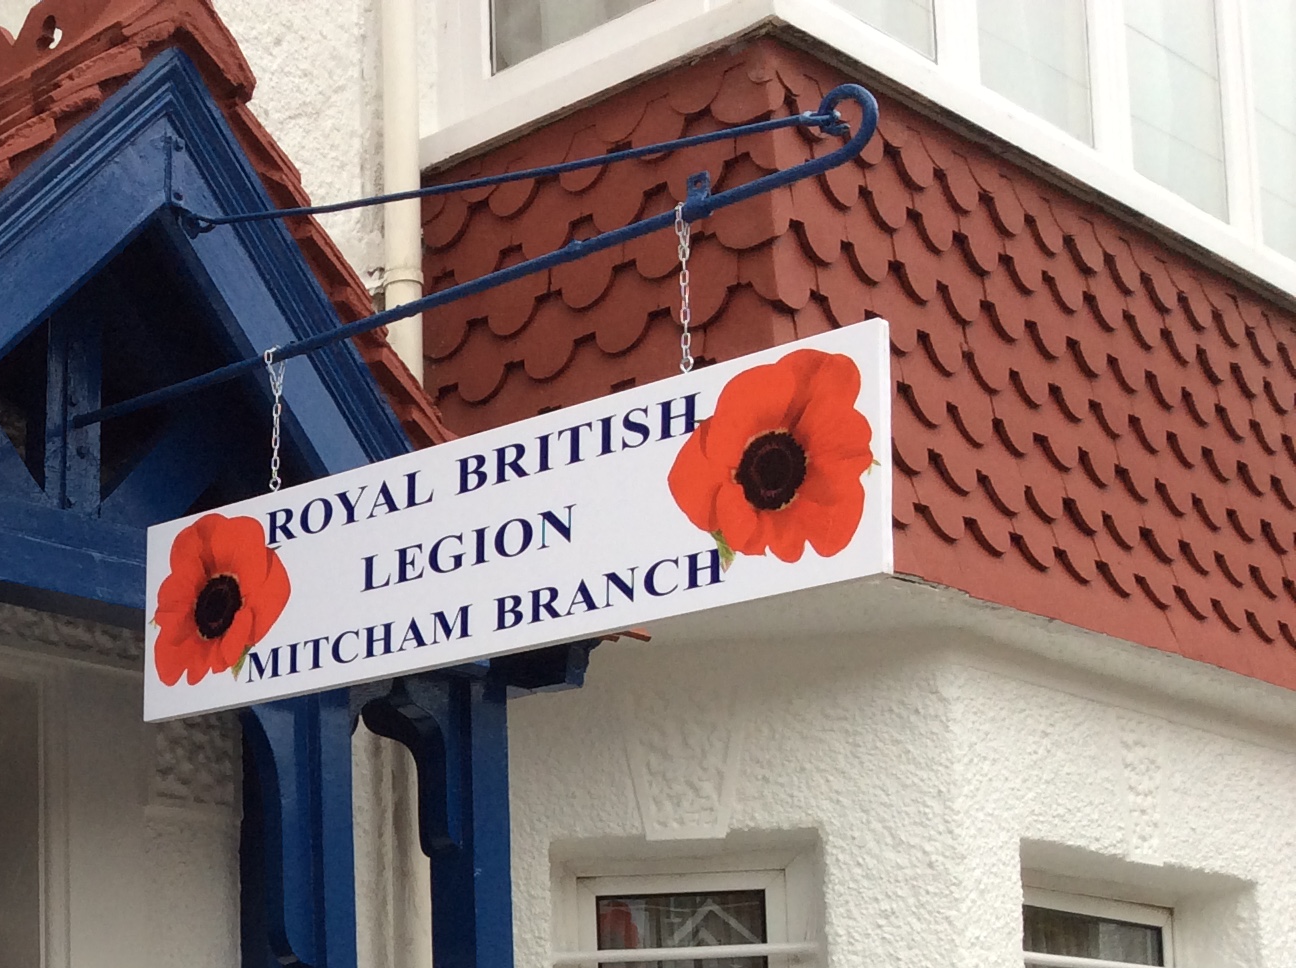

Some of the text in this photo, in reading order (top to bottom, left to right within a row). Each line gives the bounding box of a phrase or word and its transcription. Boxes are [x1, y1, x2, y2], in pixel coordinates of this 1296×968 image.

[266, 392, 702, 548] ROYAL BRITISH
[244, 548, 726, 683] MITCHAM BRANCH
[361, 505, 576, 592] LEGION
